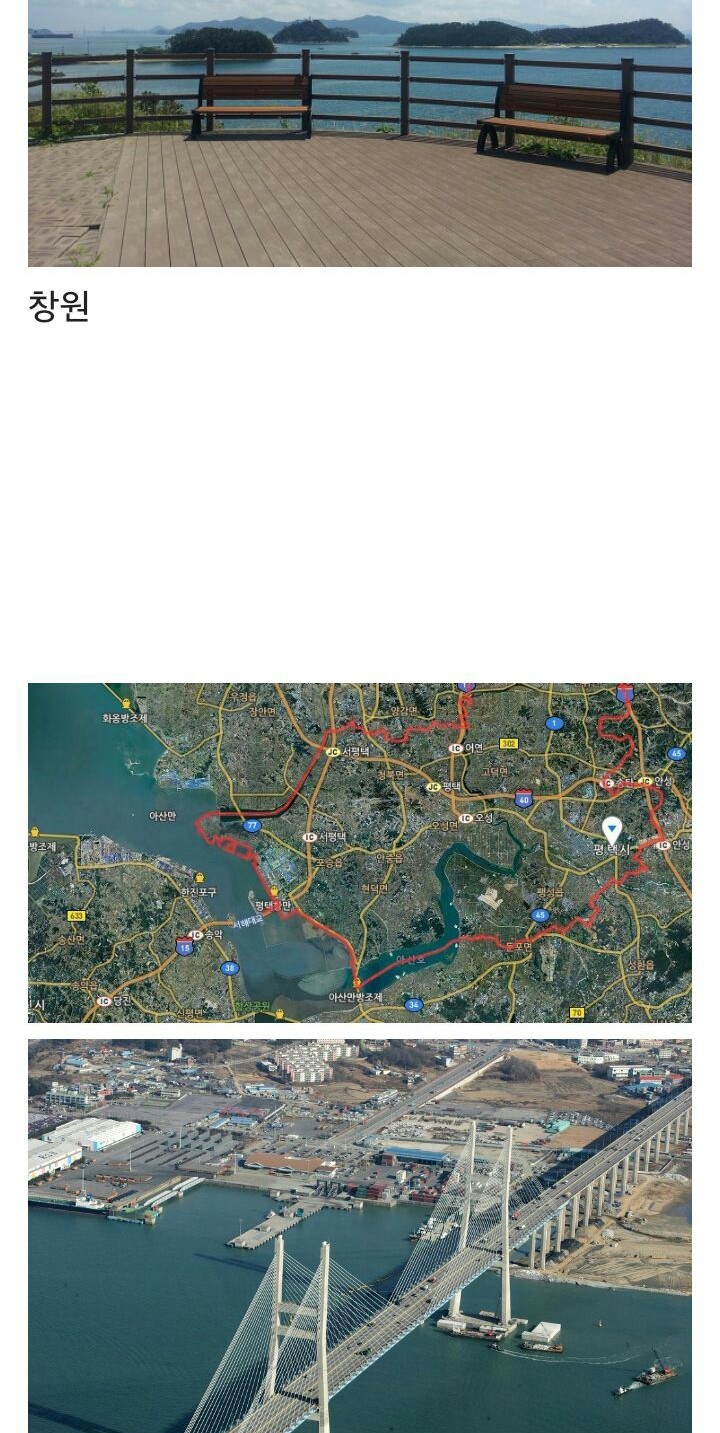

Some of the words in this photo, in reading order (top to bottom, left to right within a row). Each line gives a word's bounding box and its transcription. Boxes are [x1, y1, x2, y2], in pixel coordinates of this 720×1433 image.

[102, 714, 148, 724] 화옹방조제
[343, 746, 370, 756] 서평택
[149, 811, 177, 821] 아산만
[114, 997, 131, 1006] 당진
[329, 992, 383, 1003] 아산만방조제
